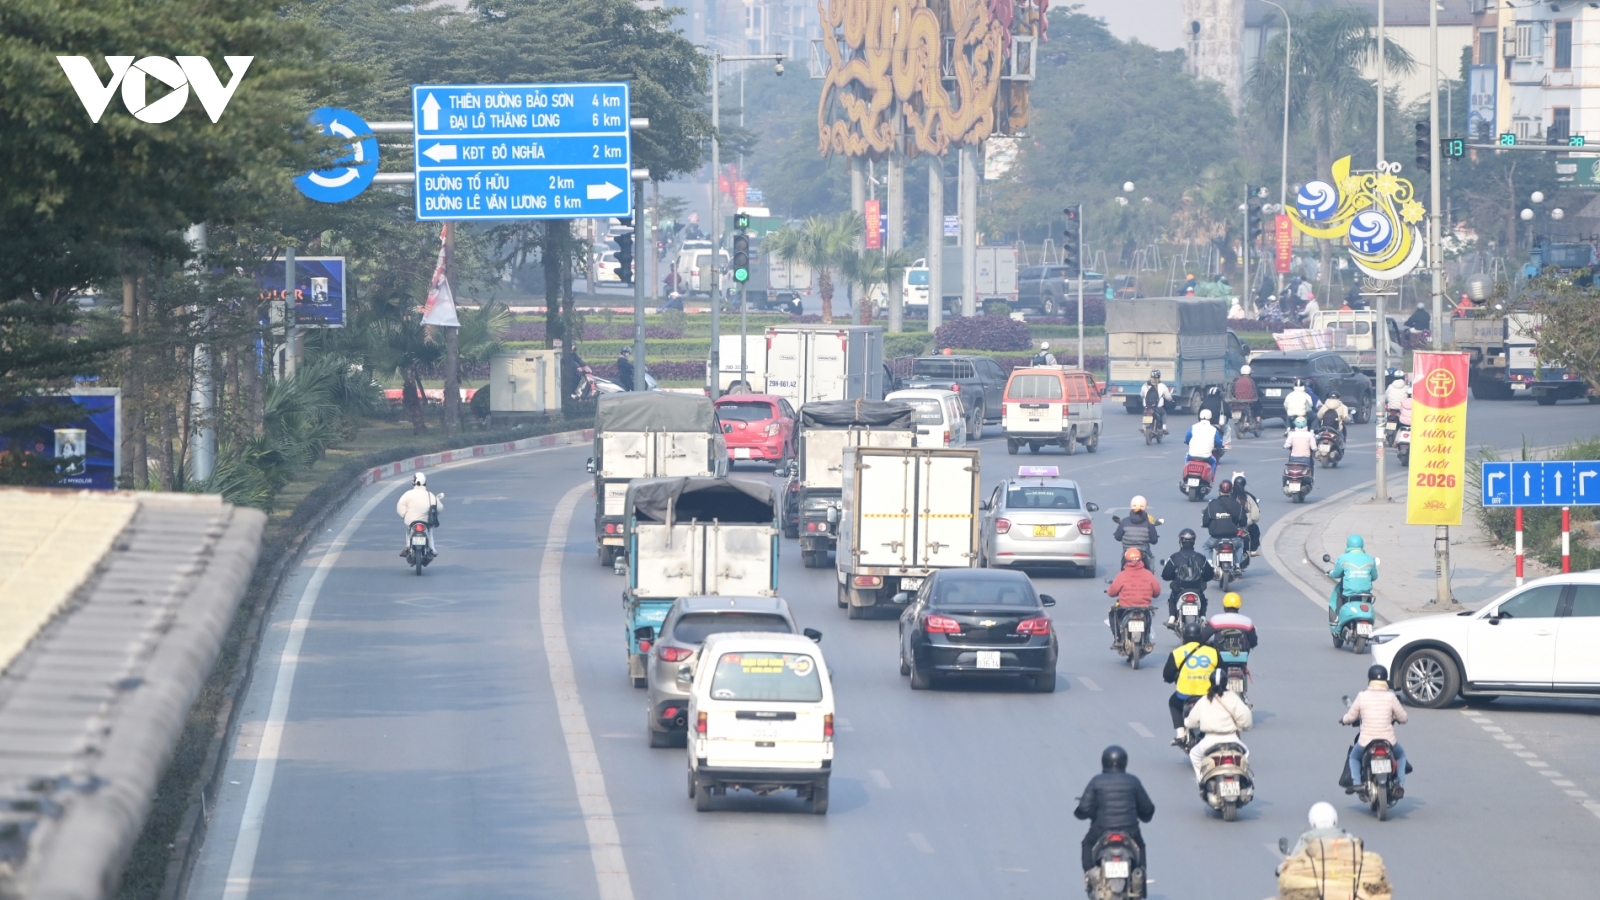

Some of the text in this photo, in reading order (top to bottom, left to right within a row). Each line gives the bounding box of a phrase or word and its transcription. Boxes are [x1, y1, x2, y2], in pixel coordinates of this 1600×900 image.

[449, 90, 620, 109] THIÊN ĐƯỜNG BẢO SƠN 4 km
[449, 112, 621, 131] ĐẠI LỘ THĂNG LONG 6 km
[1500, 135, 1514, 145] 28
[1569, 137, 1583, 146] 28
[462, 143, 622, 160] KĐT ĐÔ NGHĨA 2 km
[1450, 140, 1463, 156] 13
[425, 172, 574, 191] ĐƯỜNG TỐ HỮU 2 km
[425, 194, 581, 211] ĐƯỜNG LÊ VĂN LƯƠNG 6 km
[739, 218, 748, 226] 14
[1424, 413, 1456, 423] CHÚC
[1420, 428, 1457, 439] MỪNG
[1423, 444, 1452, 454] NĂM
[1425, 459, 1450, 469] MỚI
[1416, 473, 1456, 488] 2026
[1184, 650, 1211, 669] be
